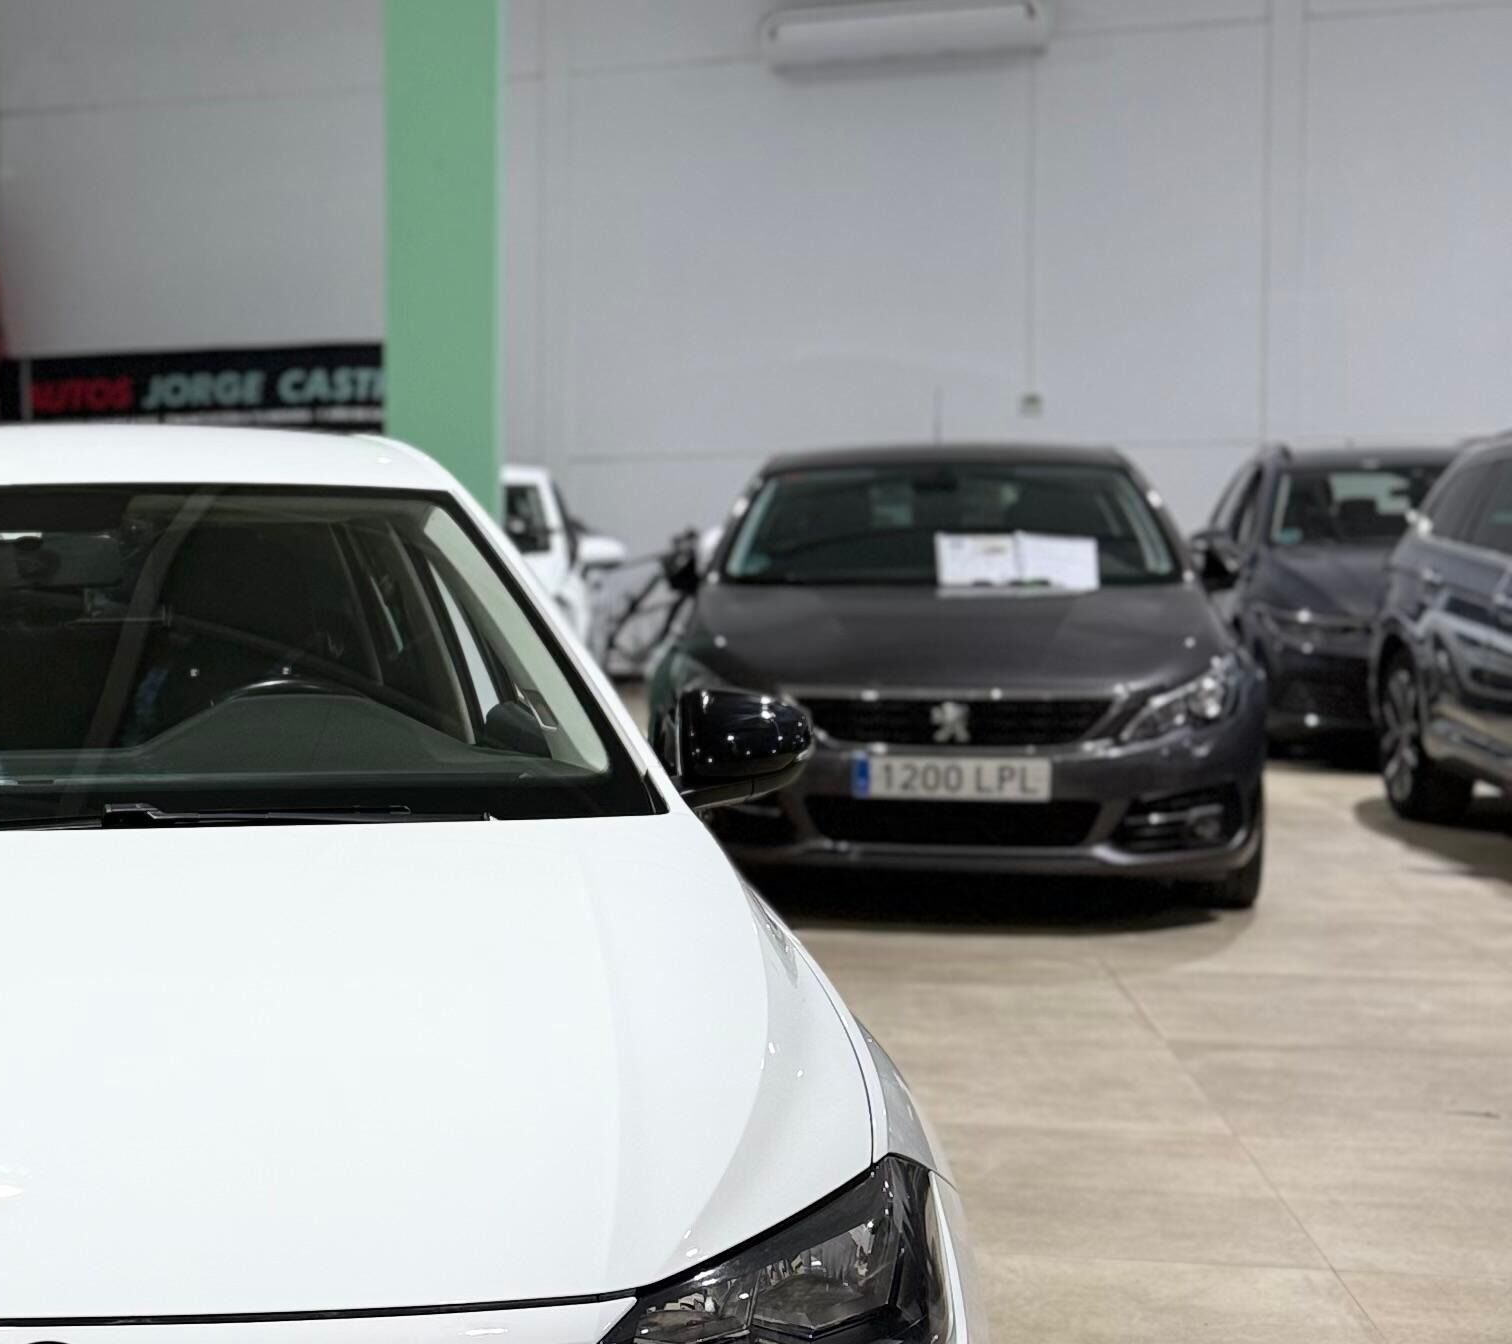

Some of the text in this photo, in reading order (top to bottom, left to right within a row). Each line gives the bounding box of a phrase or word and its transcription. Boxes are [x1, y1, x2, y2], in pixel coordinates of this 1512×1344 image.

[143, 370, 265, 409] JORGE
[882, 763, 964, 792] 1200
[974, 764, 1040, 795] LPL
